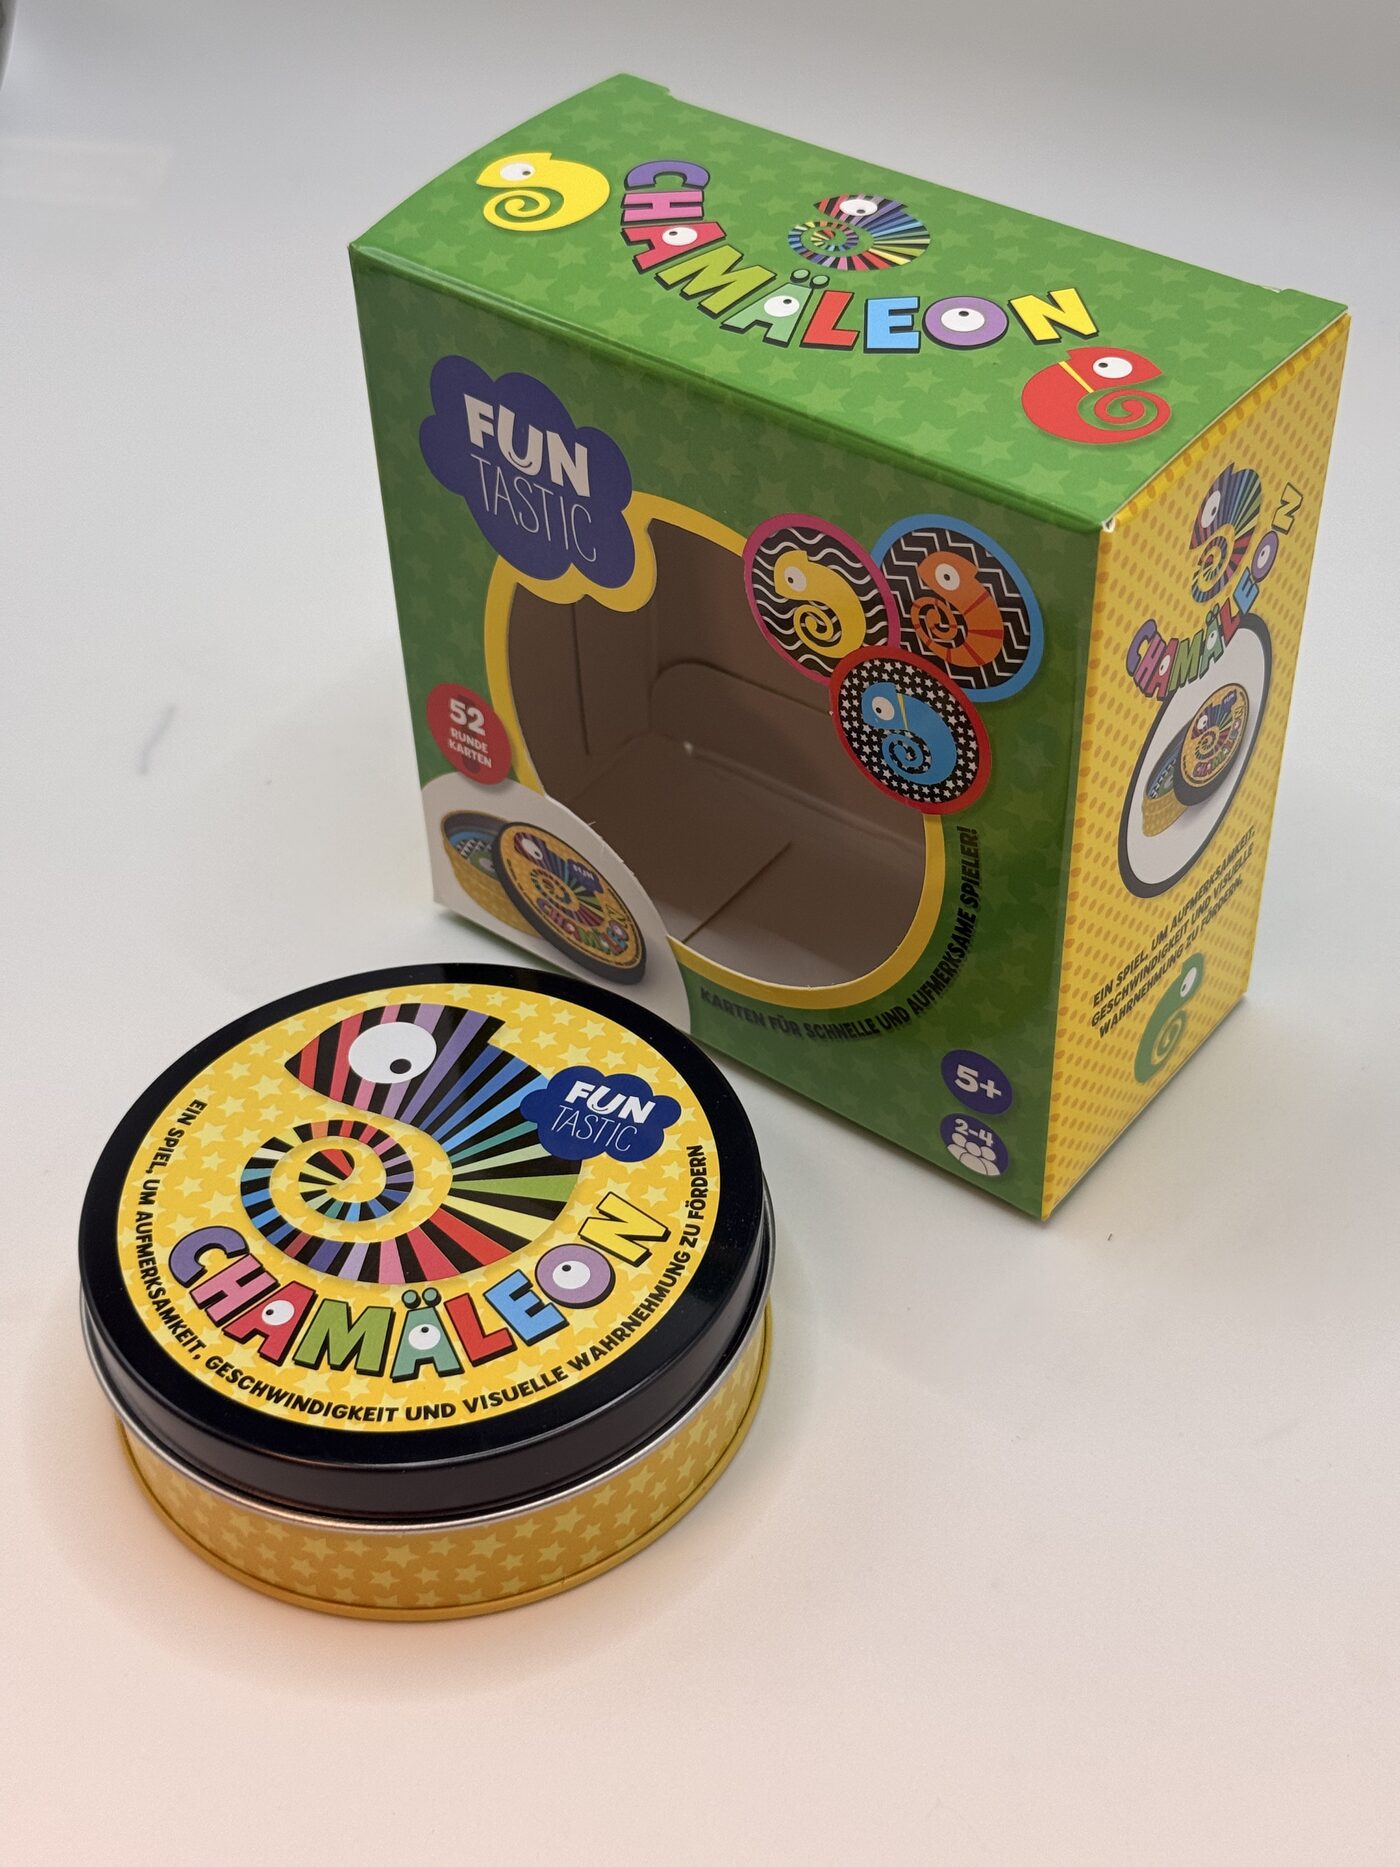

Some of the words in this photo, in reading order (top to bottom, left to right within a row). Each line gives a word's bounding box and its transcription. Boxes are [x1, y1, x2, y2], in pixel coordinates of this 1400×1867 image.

[620, 159, 1099, 353] CHAMÄLEON
[463, 393, 591, 498] FUN
[470, 453, 597, 562] TASTIC
[1126, 482, 1303, 701] CHAMÄLEON
[449, 698, 486, 736] 52
[450, 727, 489, 754] RUNDE
[448, 738, 492, 768] KARTEN
[700, 986, 766, 1027] KARTEN
[768, 1014, 802, 1037] FÜR
[803, 1018, 880, 1040] SCHNELLE
[875, 1006, 911, 1031] UND
[906, 907, 977, 1017] AUFMERKSAME
[956, 826, 980, 908] SPIELER!
[1091, 921, 1190, 1028] GESCHWINDIGKEIT
[1191, 895, 1211, 926] UND
[1213, 842, 1255, 897] VISUELLE
[1093, 980, 1114, 1008] EIN
[1116, 949, 1149, 987] SPIEL,
[1151, 927, 1169, 951] UM
[1170, 825, 1256, 932] AUFMERKSAMKEIT,
[1099, 947, 1188, 1039] WAHRNEHMUNG
[1185, 929, 1199, 951] ZU
[565, 1080, 656, 1124] FUN
[954, 1064, 1002, 1099] 5+
[177, 1099, 208, 1126] EIN
[551, 1104, 637, 1151] TASTIC
[954, 1118, 994, 1147] 2-4
[145, 1127, 185, 1174] SPIEL,
[138, 1178, 161, 1205] UM
[685, 1144, 709, 1220] FÖRDERN
[679, 1223, 701, 1248] ZU
[135, 1211, 207, 1361] AUFMERKSAMKEIT,
[168, 1191, 672, 1383] CHAMÄLEON
[567, 1250, 691, 1371] WAHRNEHMUNG
[204, 1354, 399, 1422] GESCHWINDIGKEIT
[405, 1402, 456, 1422] UND
[462, 1365, 569, 1413] VISUELLE
